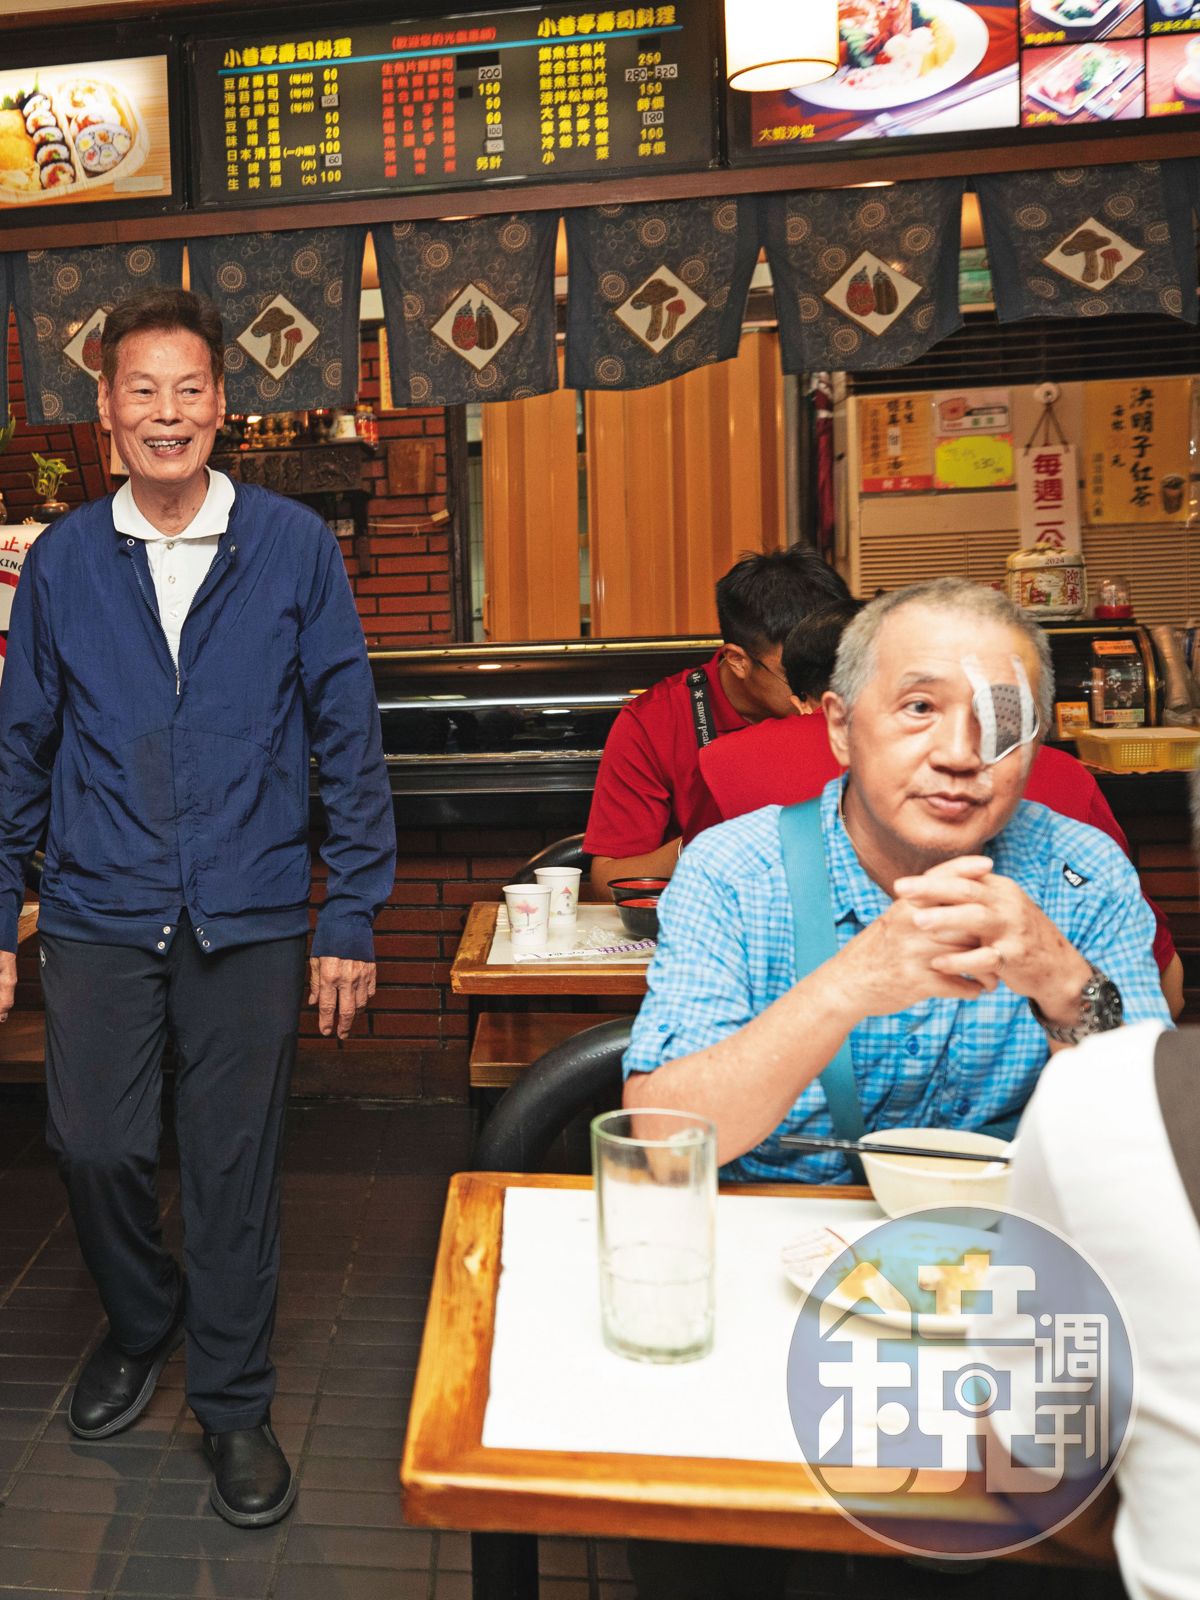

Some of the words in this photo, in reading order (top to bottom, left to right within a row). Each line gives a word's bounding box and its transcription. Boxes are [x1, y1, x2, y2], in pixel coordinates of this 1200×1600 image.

[480, 69, 500, 79] 200
[325, 126, 340, 139] 20
[319, 141, 341, 154] 100
[320, 170, 342, 182] 100
[1130, 387, 1155, 507] 決明子紅茶
[1044, 557, 1065, 566] 2024
[1065, 569, 1081, 606] 迎春
[696, 701, 707, 724] snow
